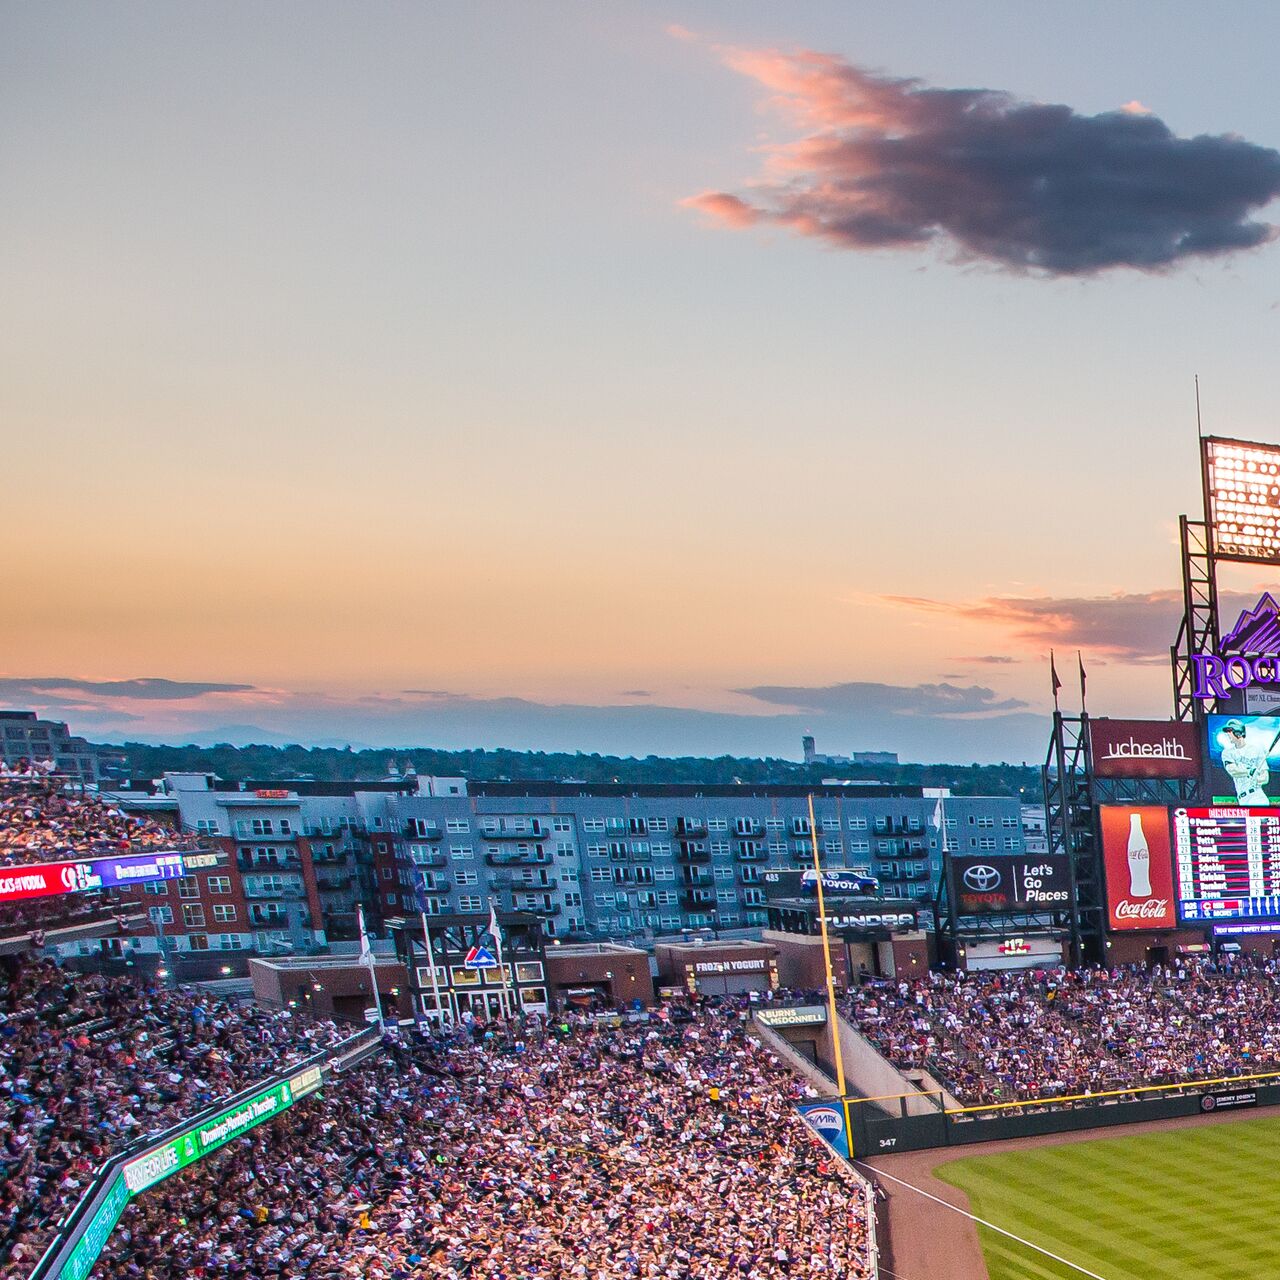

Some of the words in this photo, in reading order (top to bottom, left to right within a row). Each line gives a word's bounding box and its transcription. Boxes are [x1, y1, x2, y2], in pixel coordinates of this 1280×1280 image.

[1108, 737, 1185, 758] uchealth
[1023, 865, 1053, 876] Let's
[765, 873, 780, 882] 485
[1024, 877, 1042, 889] Go
[822, 879, 860, 890] TOYOTA
[961, 893, 1007, 903] TOYOTA
[1025, 890, 1069, 902] Places
[1115, 899, 1168, 919] Coca-Cola
[731, 959, 765, 970] YOGURT
[765, 1009, 797, 1018] BURNS
[1216, 1095, 1235, 1103] JIMMY
[1236, 1093, 1256, 1101] JOHN'S
[879, 1138, 897, 1147] 347
